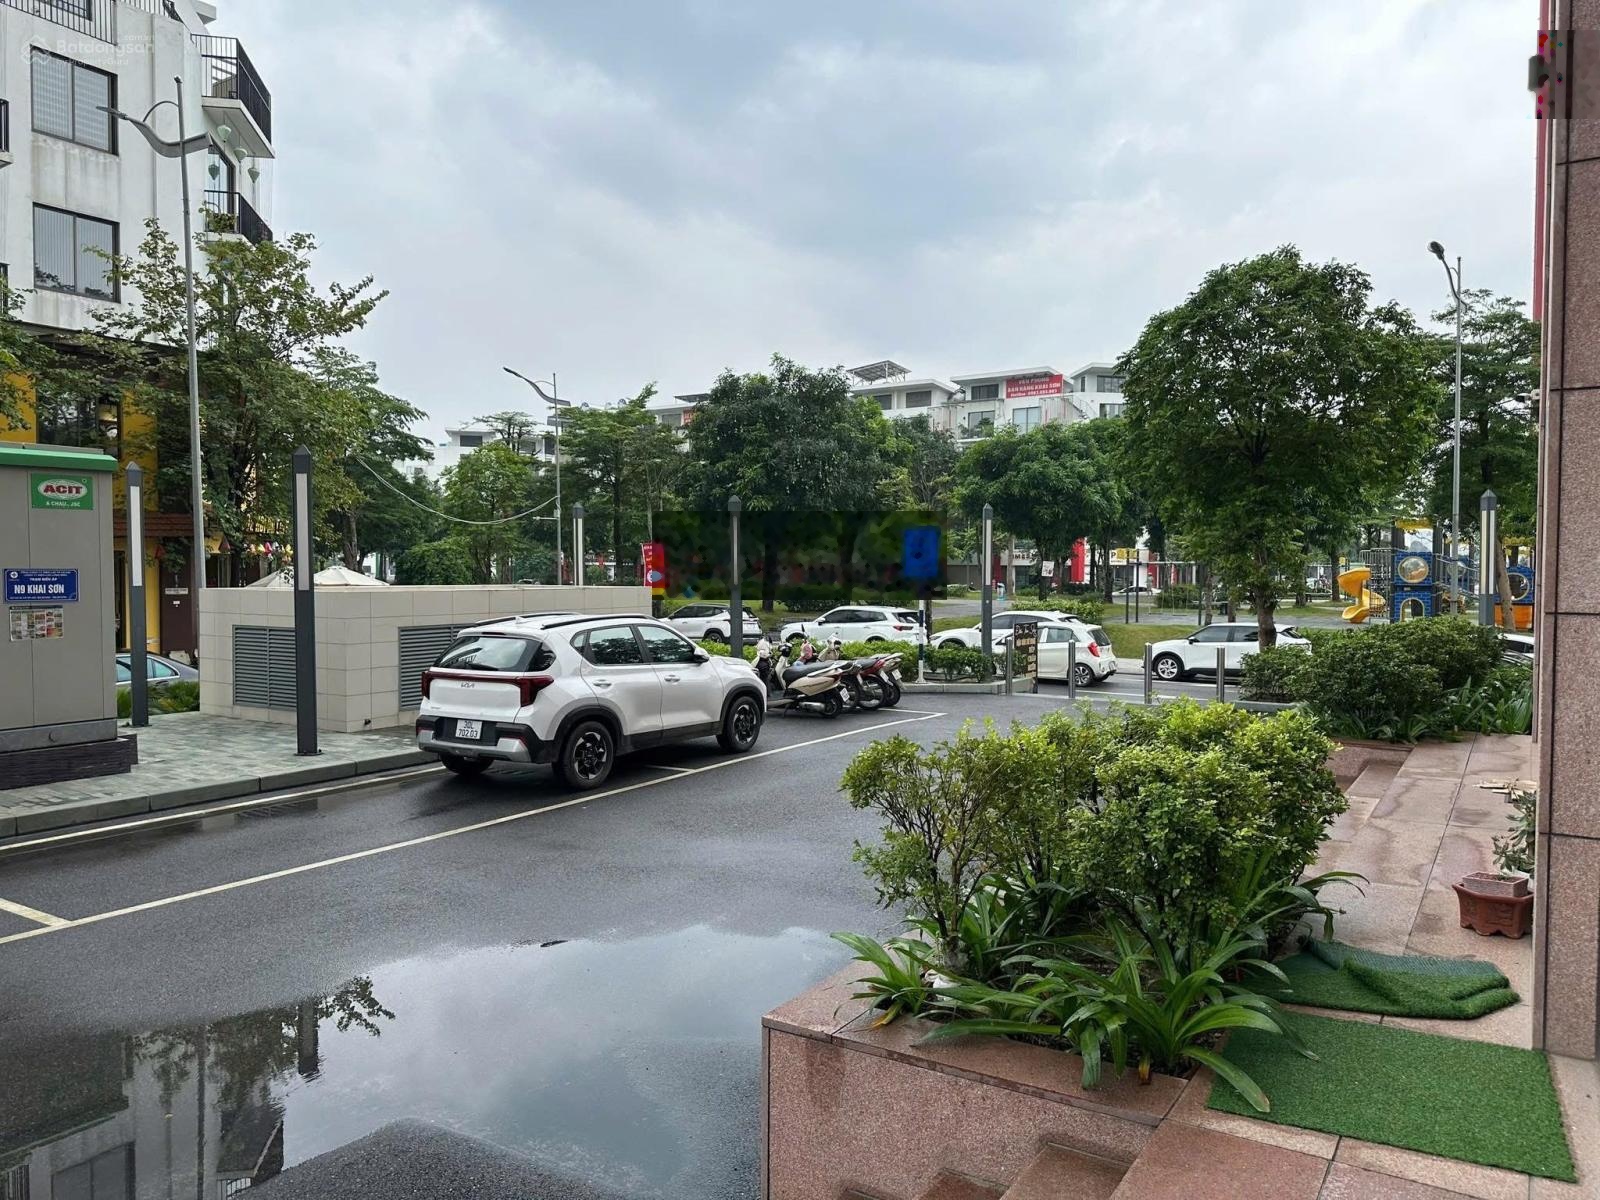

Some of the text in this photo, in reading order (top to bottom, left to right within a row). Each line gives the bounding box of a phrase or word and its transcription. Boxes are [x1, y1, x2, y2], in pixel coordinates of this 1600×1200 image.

[43, 484, 82, 494] ACIT
[14, 584, 64, 594] N9 KHAI SƠN
